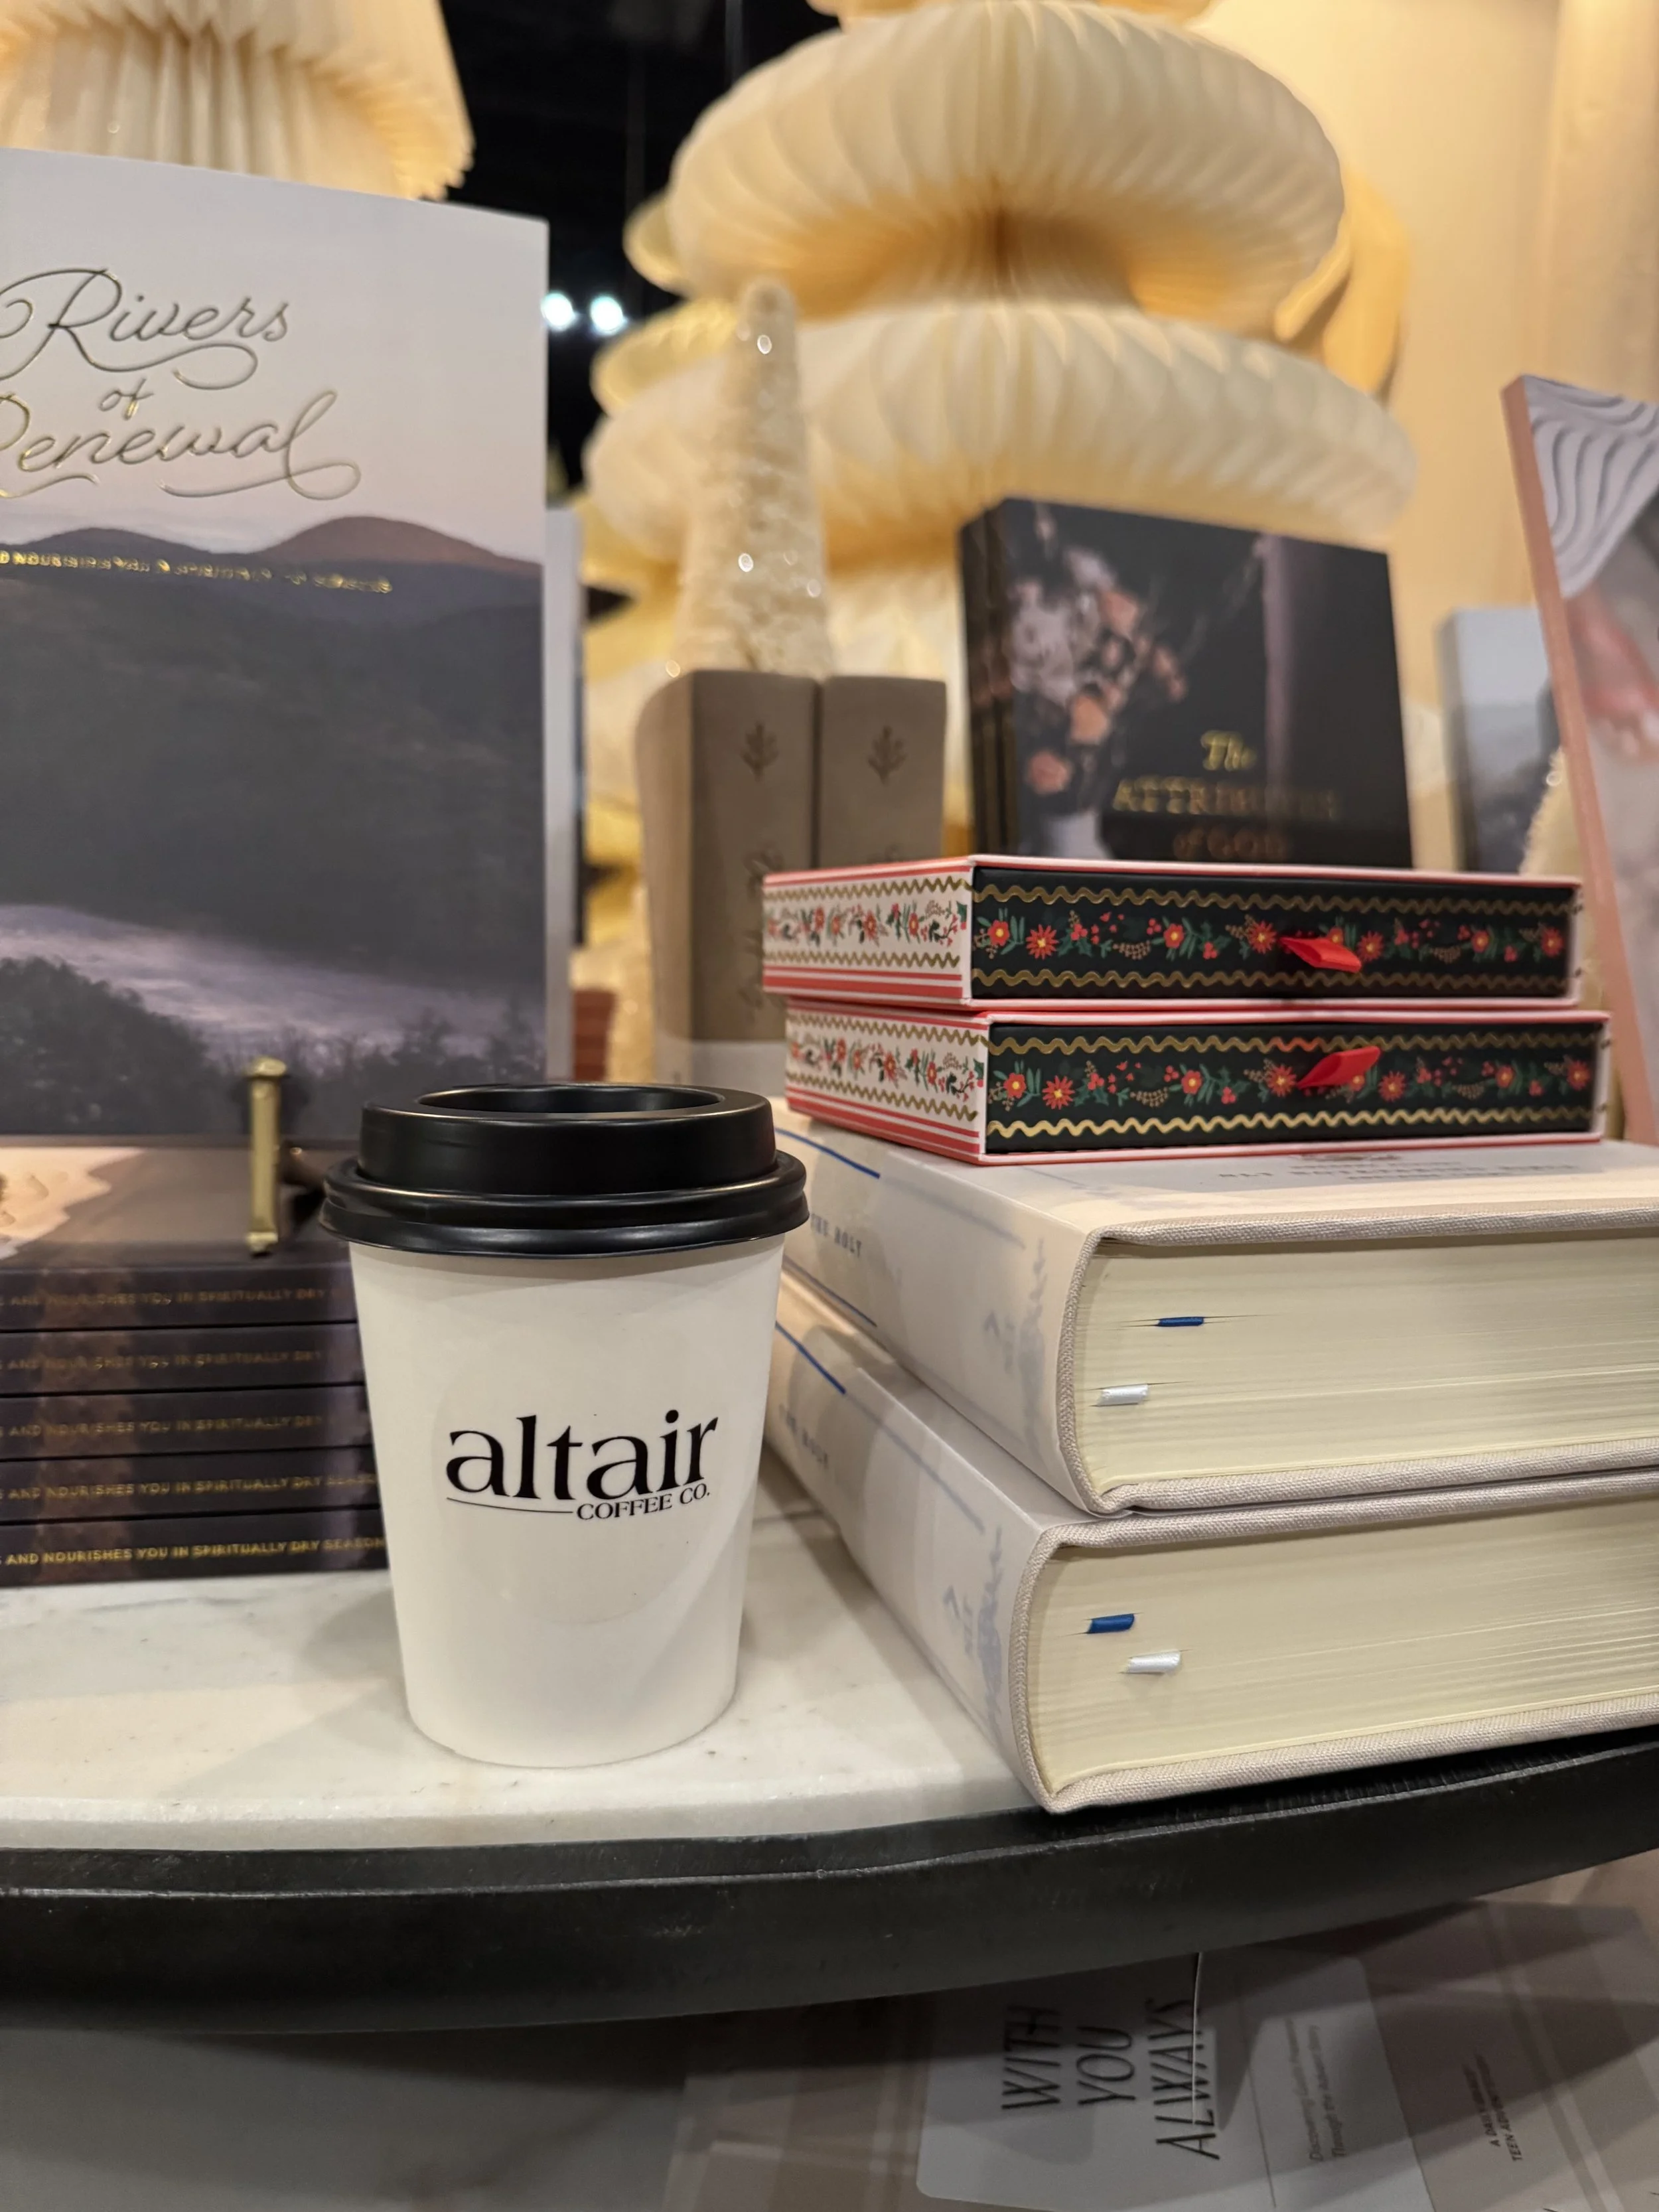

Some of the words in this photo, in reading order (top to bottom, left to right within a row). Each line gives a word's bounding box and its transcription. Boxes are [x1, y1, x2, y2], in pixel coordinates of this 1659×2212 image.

[99, 378, 155, 420] of
[445, 1409, 719, 1501] altair
[7, 1487, 41, 1500] AND
[139, 1481, 171, 1494] YOU
[175, 1480, 191, 1493] IN
[194, 1477, 288, 1493] SPIRITUALLY
[576, 1493, 673, 1521] COFFEE
[679, 1483, 711, 1506] CO.
[5, 1551, 39, 1566] AND
[42, 1547, 133, 1564] NOURISHES
[136, 1546, 169, 1560] YOU
[173, 1544, 190, 1558] IN
[192, 1540, 287, 1558] SPIRITUALLY
[289, 1538, 321, 1554] DRY
[1001, 2004, 1061, 2110] WITH
[1075, 2026, 1136, 2106] YOU
[1144, 1997, 1221, 2161] ALWAYS
